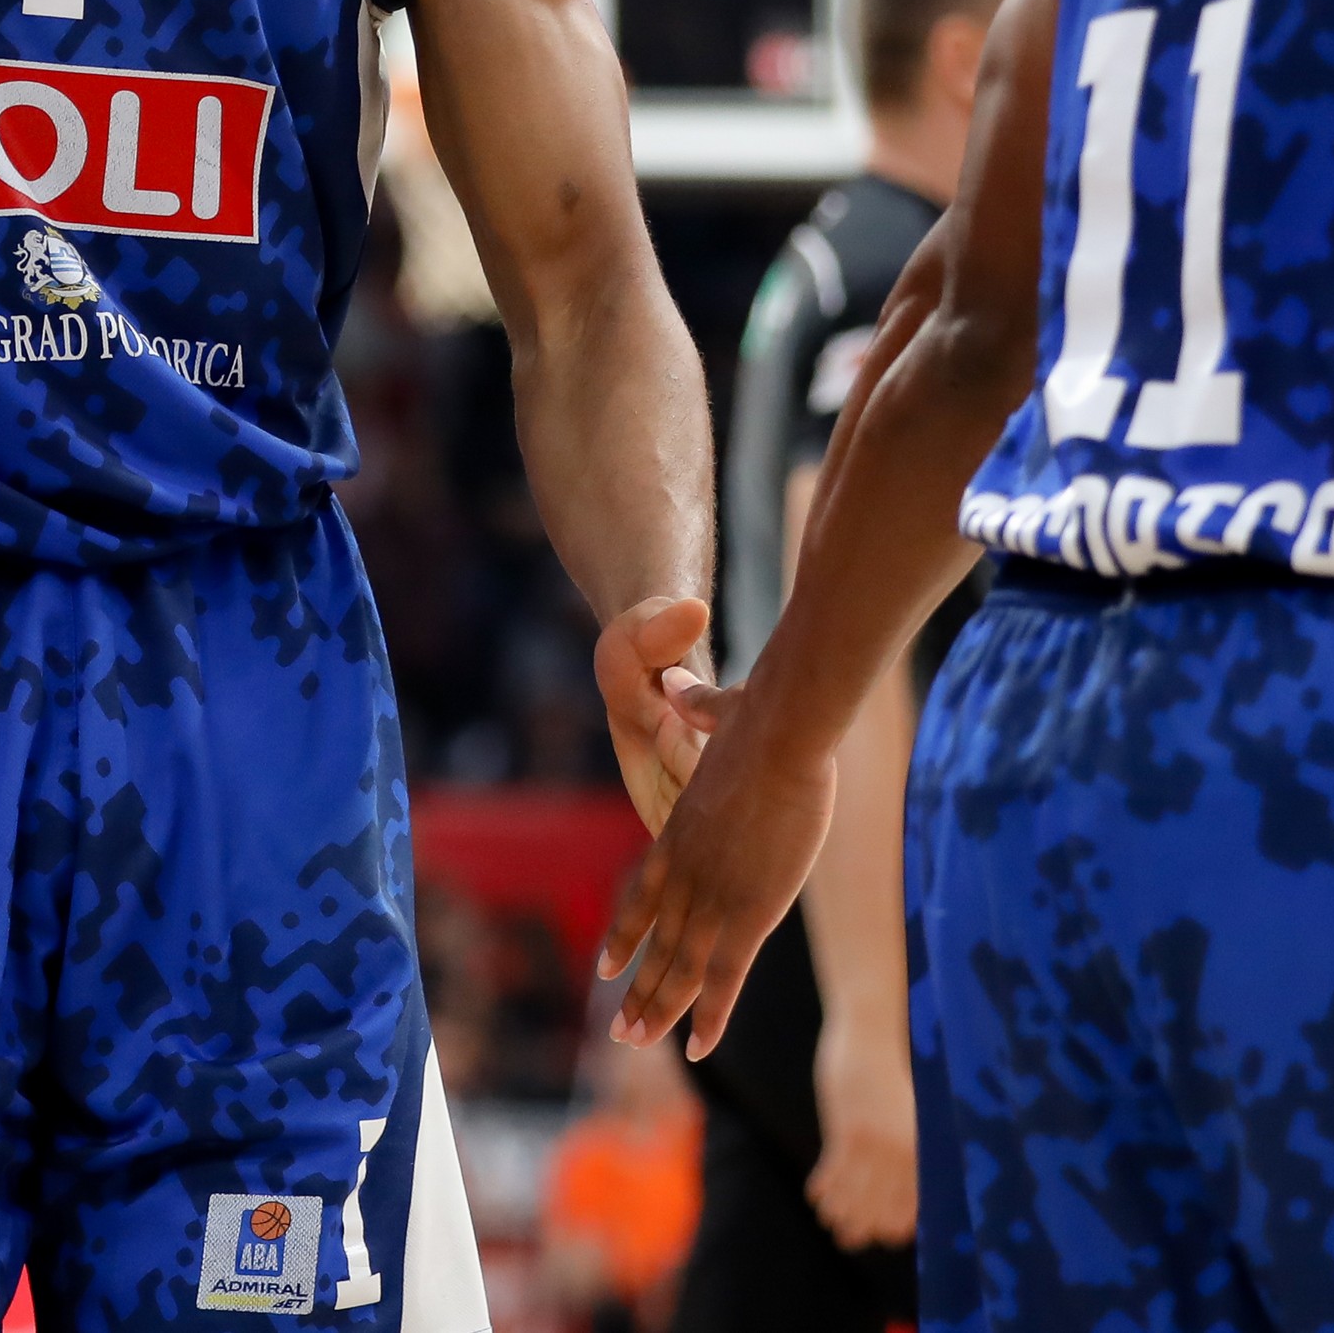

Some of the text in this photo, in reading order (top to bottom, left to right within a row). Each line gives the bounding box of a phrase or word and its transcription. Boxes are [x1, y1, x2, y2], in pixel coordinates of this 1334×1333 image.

[334, 1117, 387, 1311] 1
[239, 1243, 279, 1271] ABA
[211, 1279, 308, 1297] ADMIRAL
